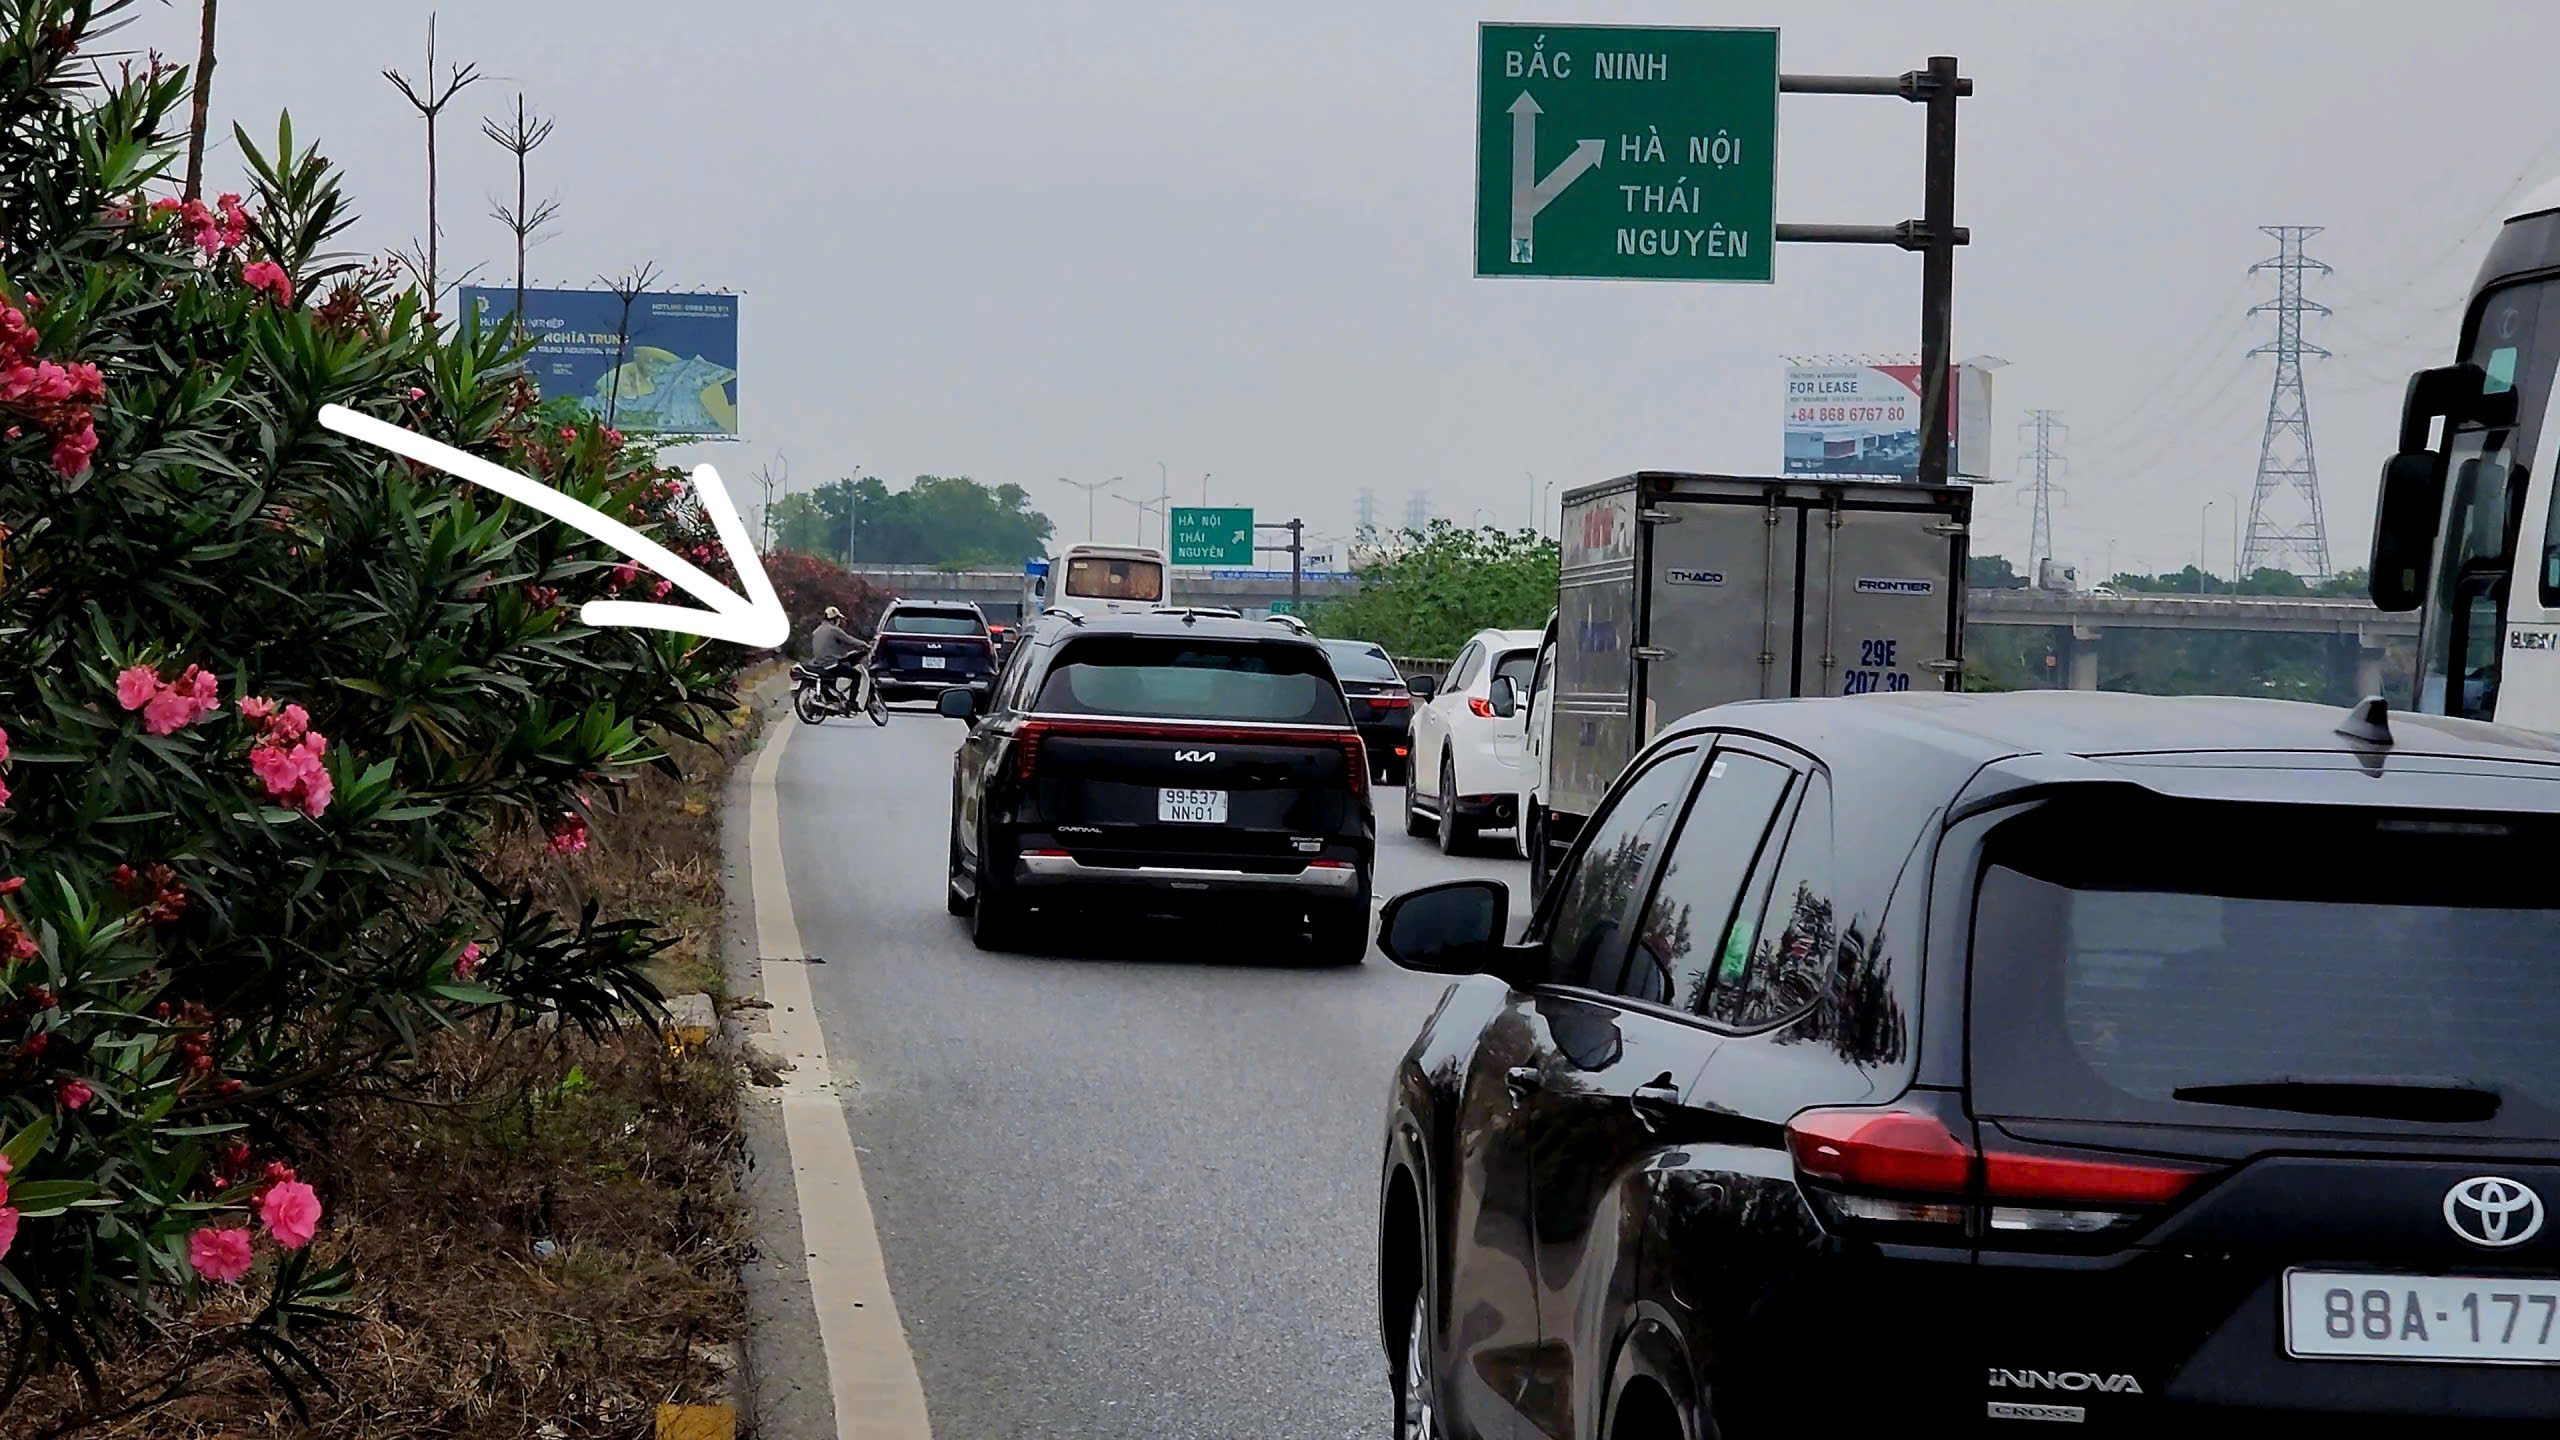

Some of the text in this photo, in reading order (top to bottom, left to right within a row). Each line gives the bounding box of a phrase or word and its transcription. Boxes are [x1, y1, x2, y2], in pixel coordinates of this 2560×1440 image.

[1505, 34, 1668, 81] BẮC NINH
[1620, 125, 1741, 170] HÀ NỘI
[1619, 176, 1700, 214] THÁI
[1616, 222, 1748, 258] NGUYÊN
[1789, 381, 1858, 393] FOR LEASE
[1790, 406, 1905, 422] +84 868 6767 80
[1178, 512, 1221, 528] HÀ NỘI
[1178, 530, 1205, 543] THÁI
[1178, 545, 1224, 558] NGUYÊN
[1671, 570, 1723, 583] THACO
[1858, 579, 1931, 593] FRONTIER
[1861, 639, 1897, 667] 29E
[2324, 1288, 2556, 1345] 88A-177
[1994, 1406, 2078, 1418] CROSS
